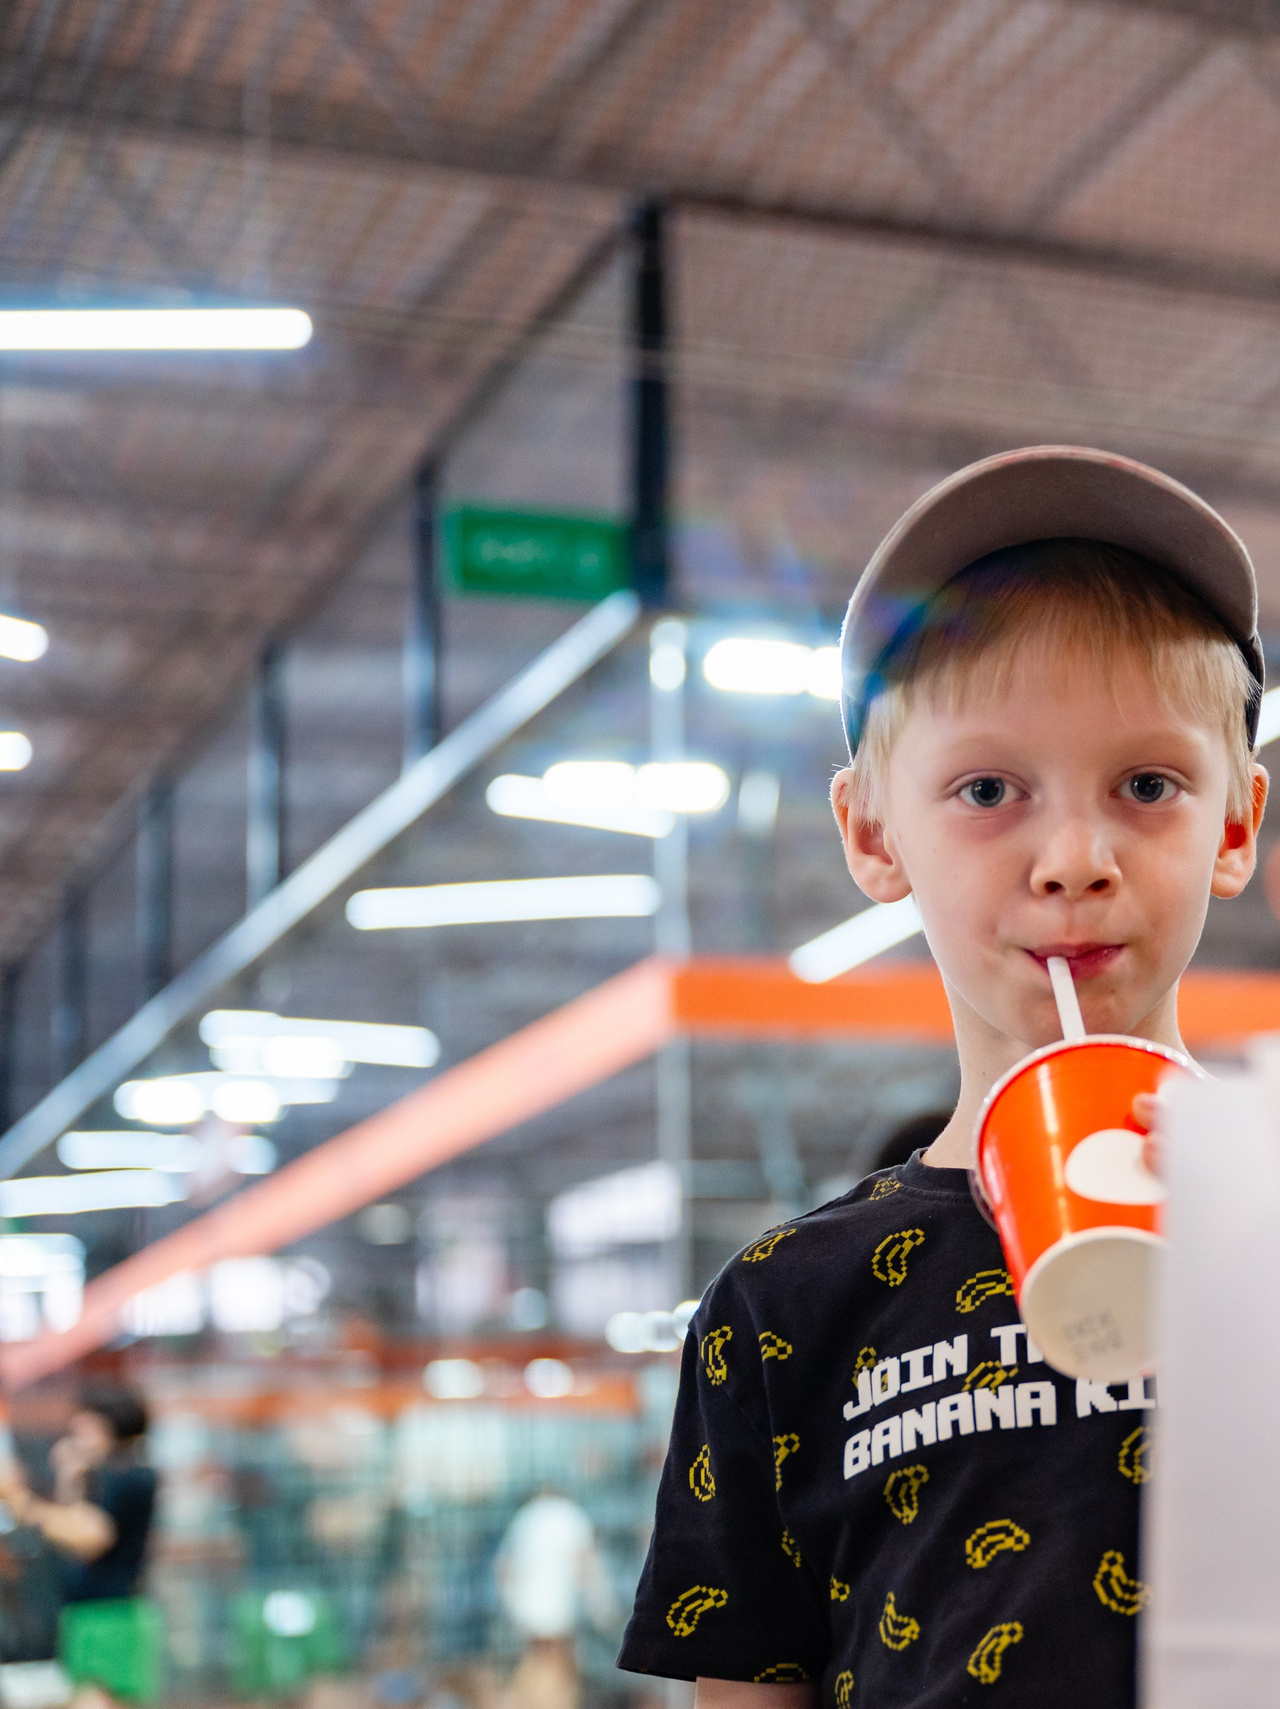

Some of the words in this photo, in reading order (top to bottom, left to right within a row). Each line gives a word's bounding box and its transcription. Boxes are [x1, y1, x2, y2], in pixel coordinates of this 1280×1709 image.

[843, 1334, 968, 1421] JOIN
[844, 1381, 1057, 1480] BANANA
[1075, 1376, 1157, 1418] KI
